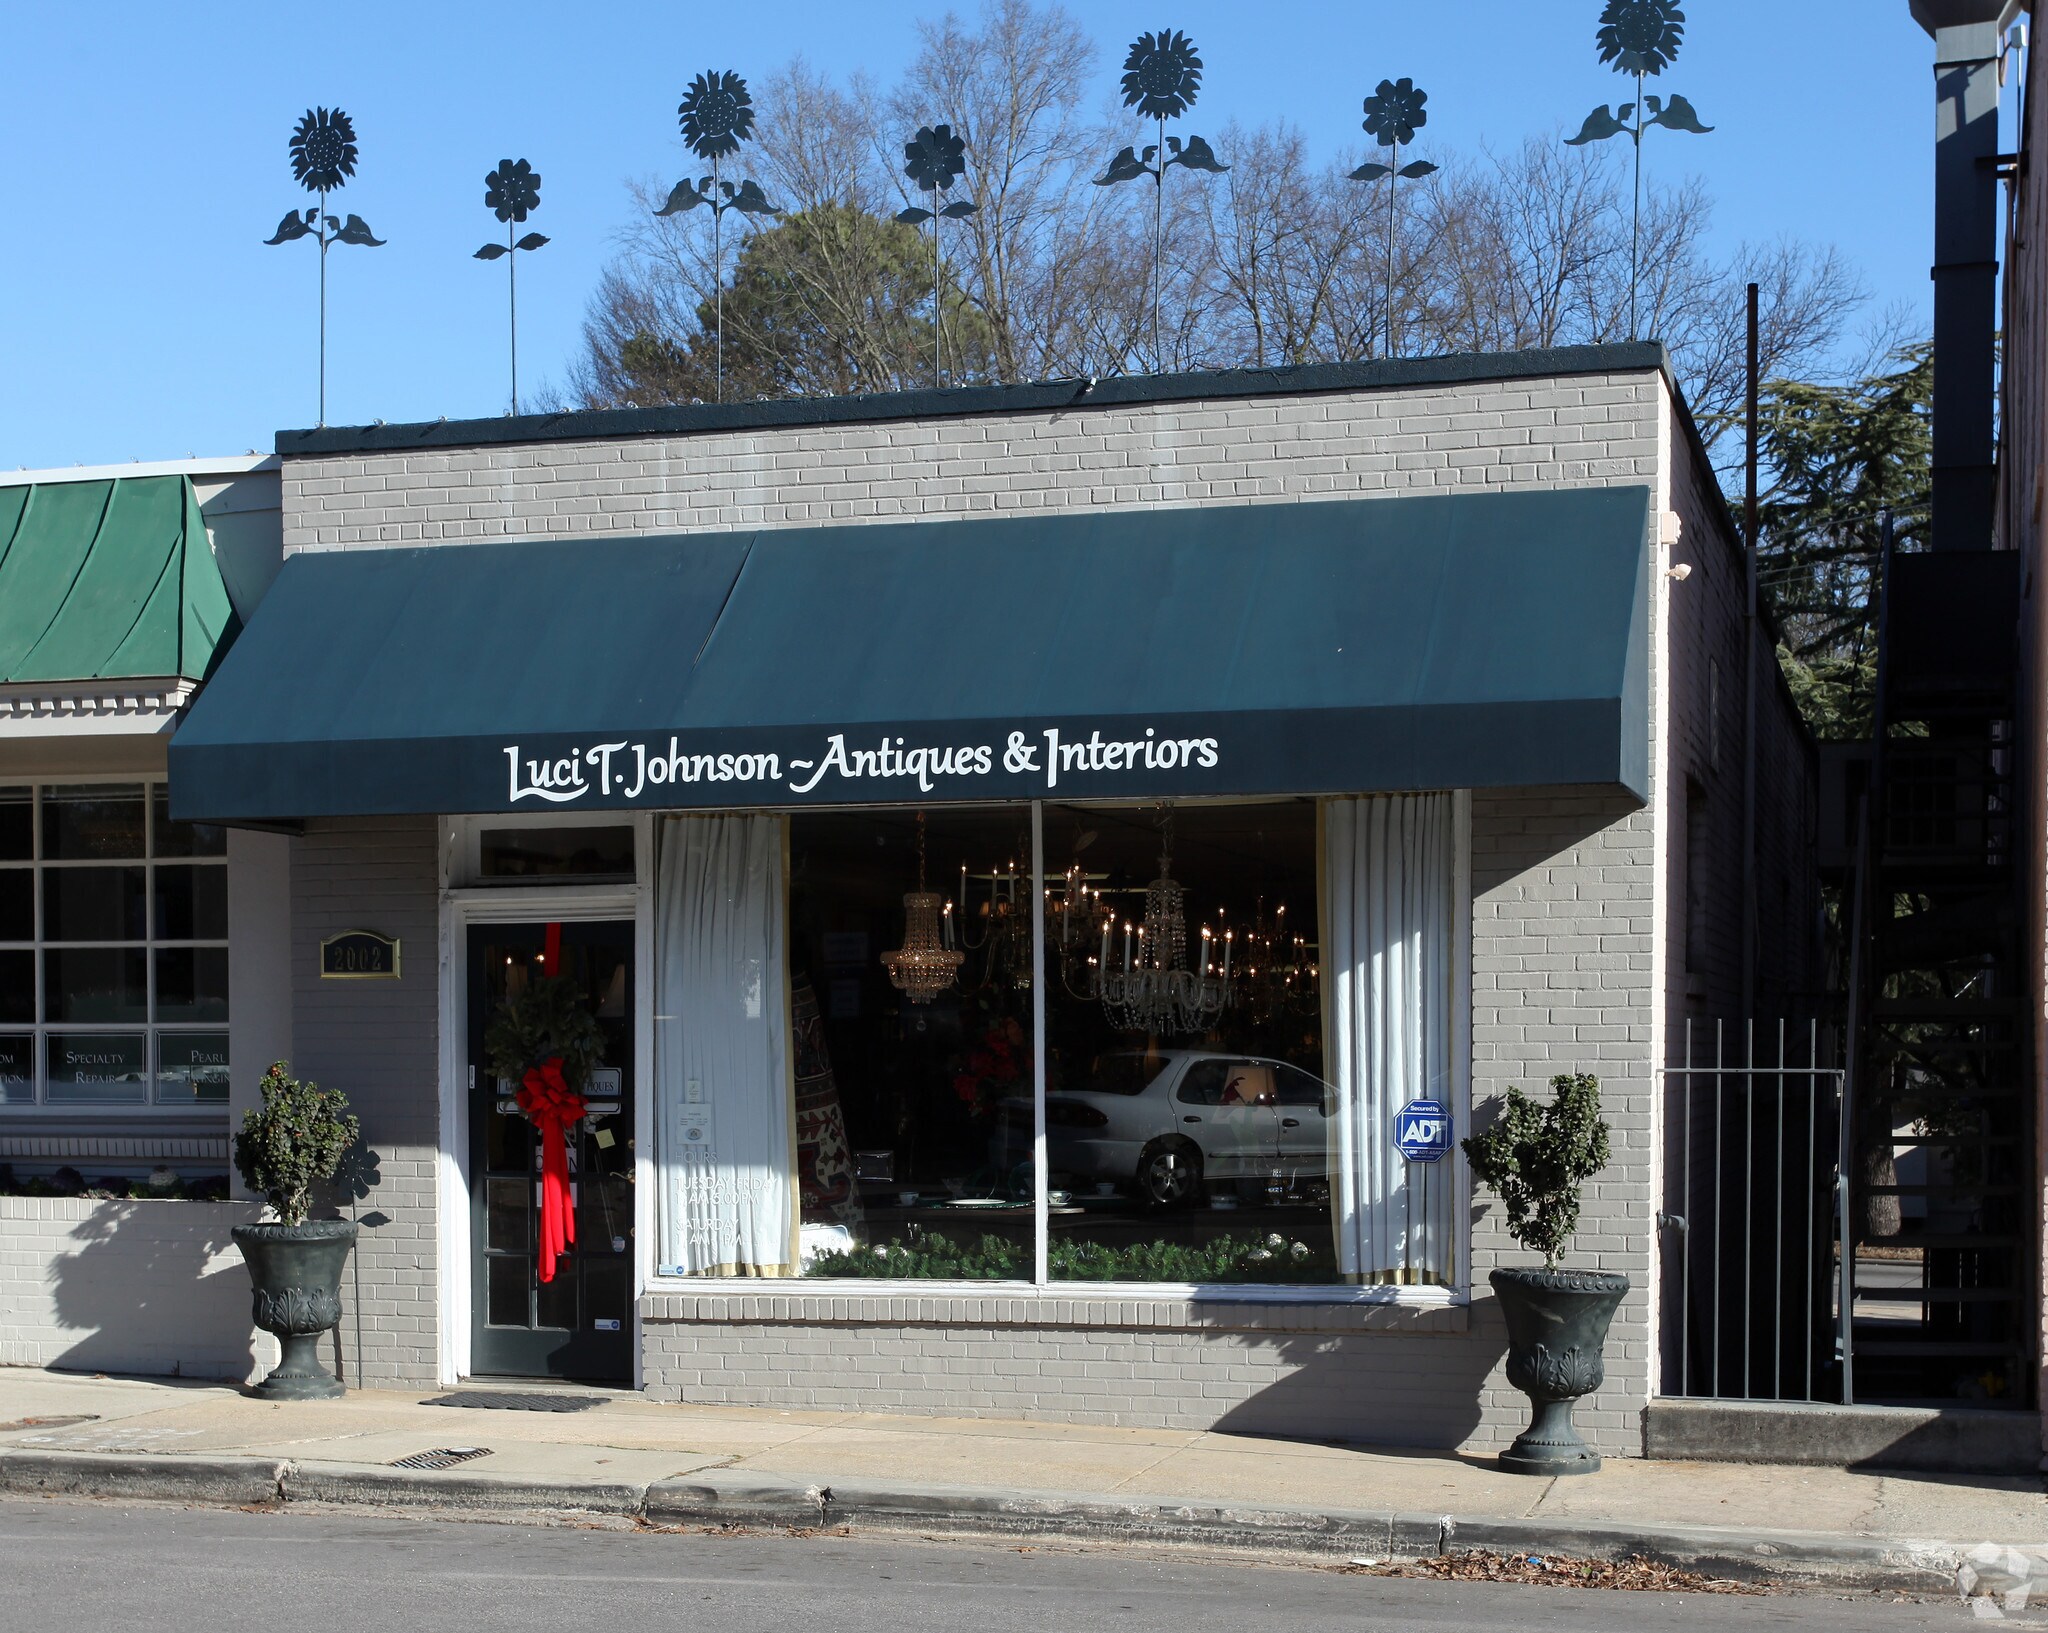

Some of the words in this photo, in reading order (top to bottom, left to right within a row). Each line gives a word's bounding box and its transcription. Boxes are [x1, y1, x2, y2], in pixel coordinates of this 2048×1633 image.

[504, 746, 589, 802] Luci
[586, 741, 624, 796] T.
[625, 737, 783, 799] Johnson
[1003, 731, 1041, 774] &
[1043, 728, 1219, 787] Interiors
[334, 946, 382, 971] 2002
[66, 1051, 125, 1064] SPECIALTY
[190, 1050, 226, 1063] PEARL
[75, 1071, 116, 1085] REPAIR
[1402, 1119, 1447, 1144] ADT
[675, 1218, 739, 1232] SATURDAY
